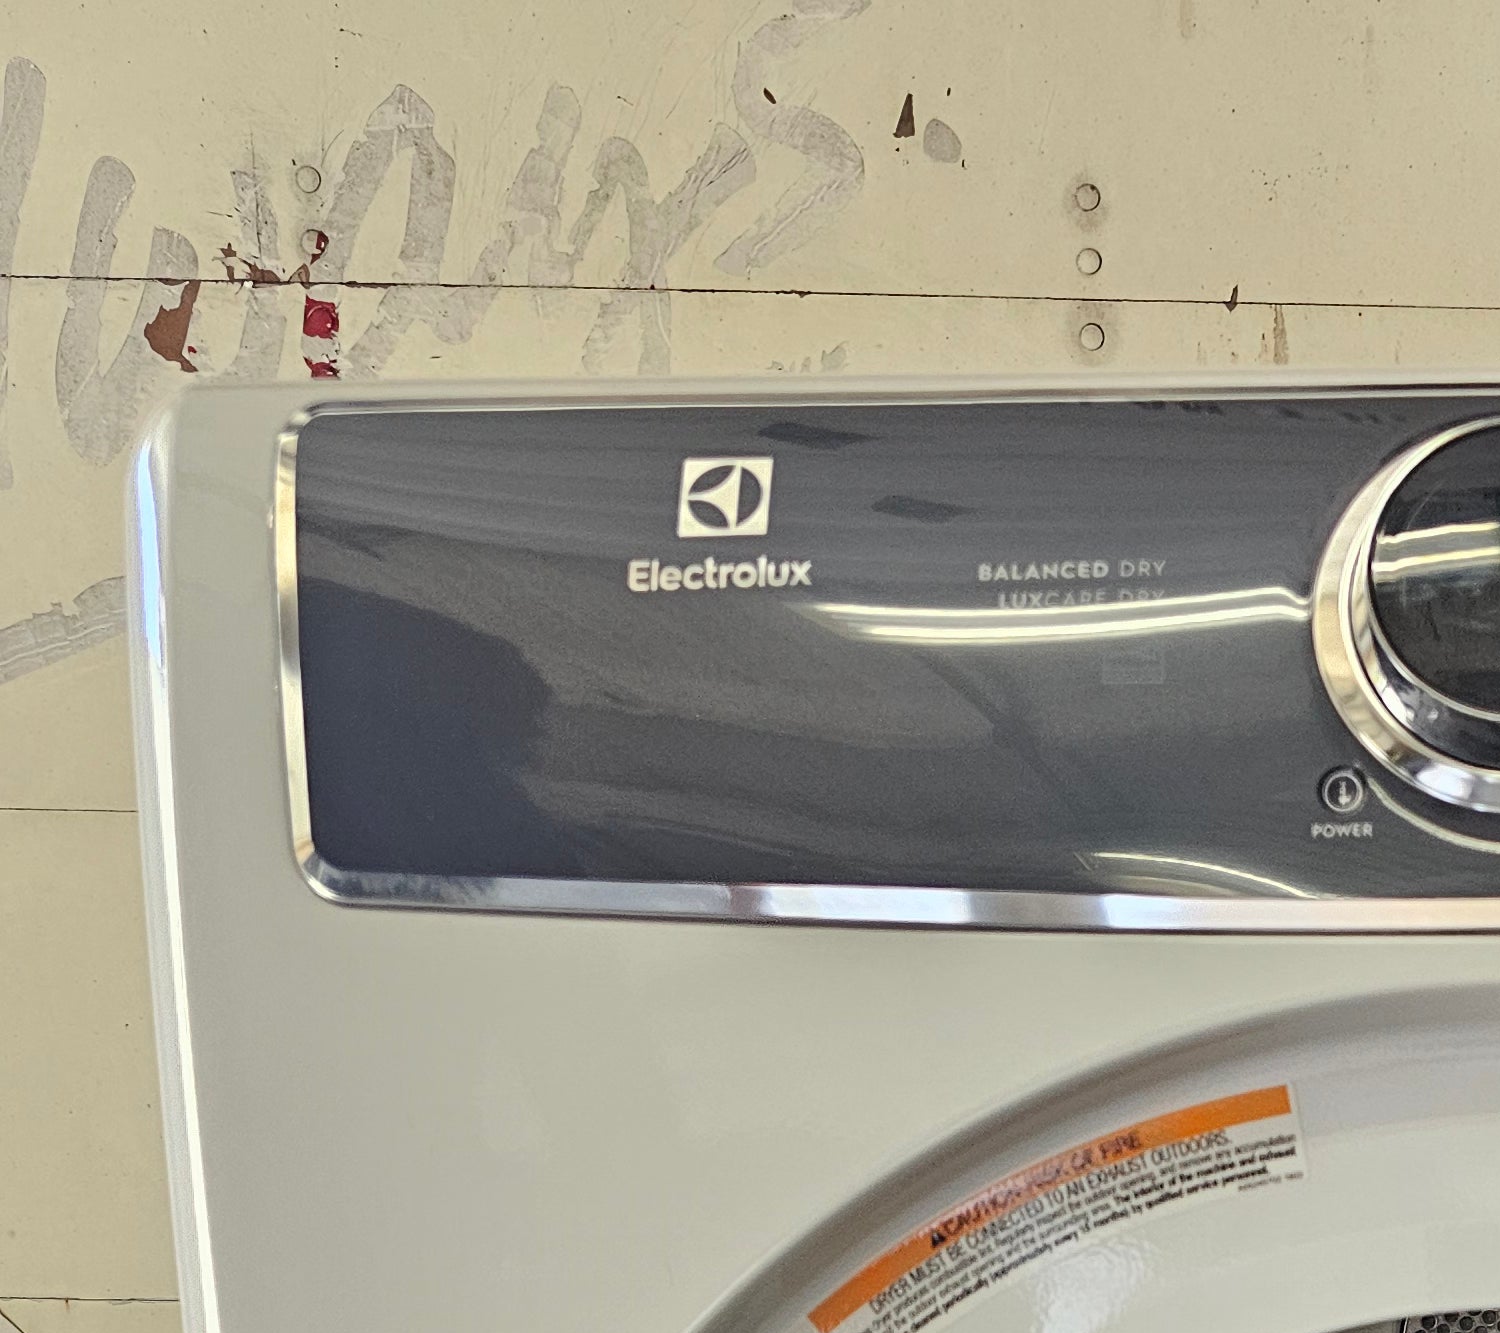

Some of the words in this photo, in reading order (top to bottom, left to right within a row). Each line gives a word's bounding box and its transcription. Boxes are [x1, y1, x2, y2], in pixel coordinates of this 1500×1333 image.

[627, 556, 812, 594] Electrolux
[977, 561, 1110, 582] BALANCED
[1119, 559, 1167, 578] DRY
[1311, 823, 1373, 838] POWER
[868, 1276, 913, 1315] DRYER
[909, 1252, 948, 1287] MUST
